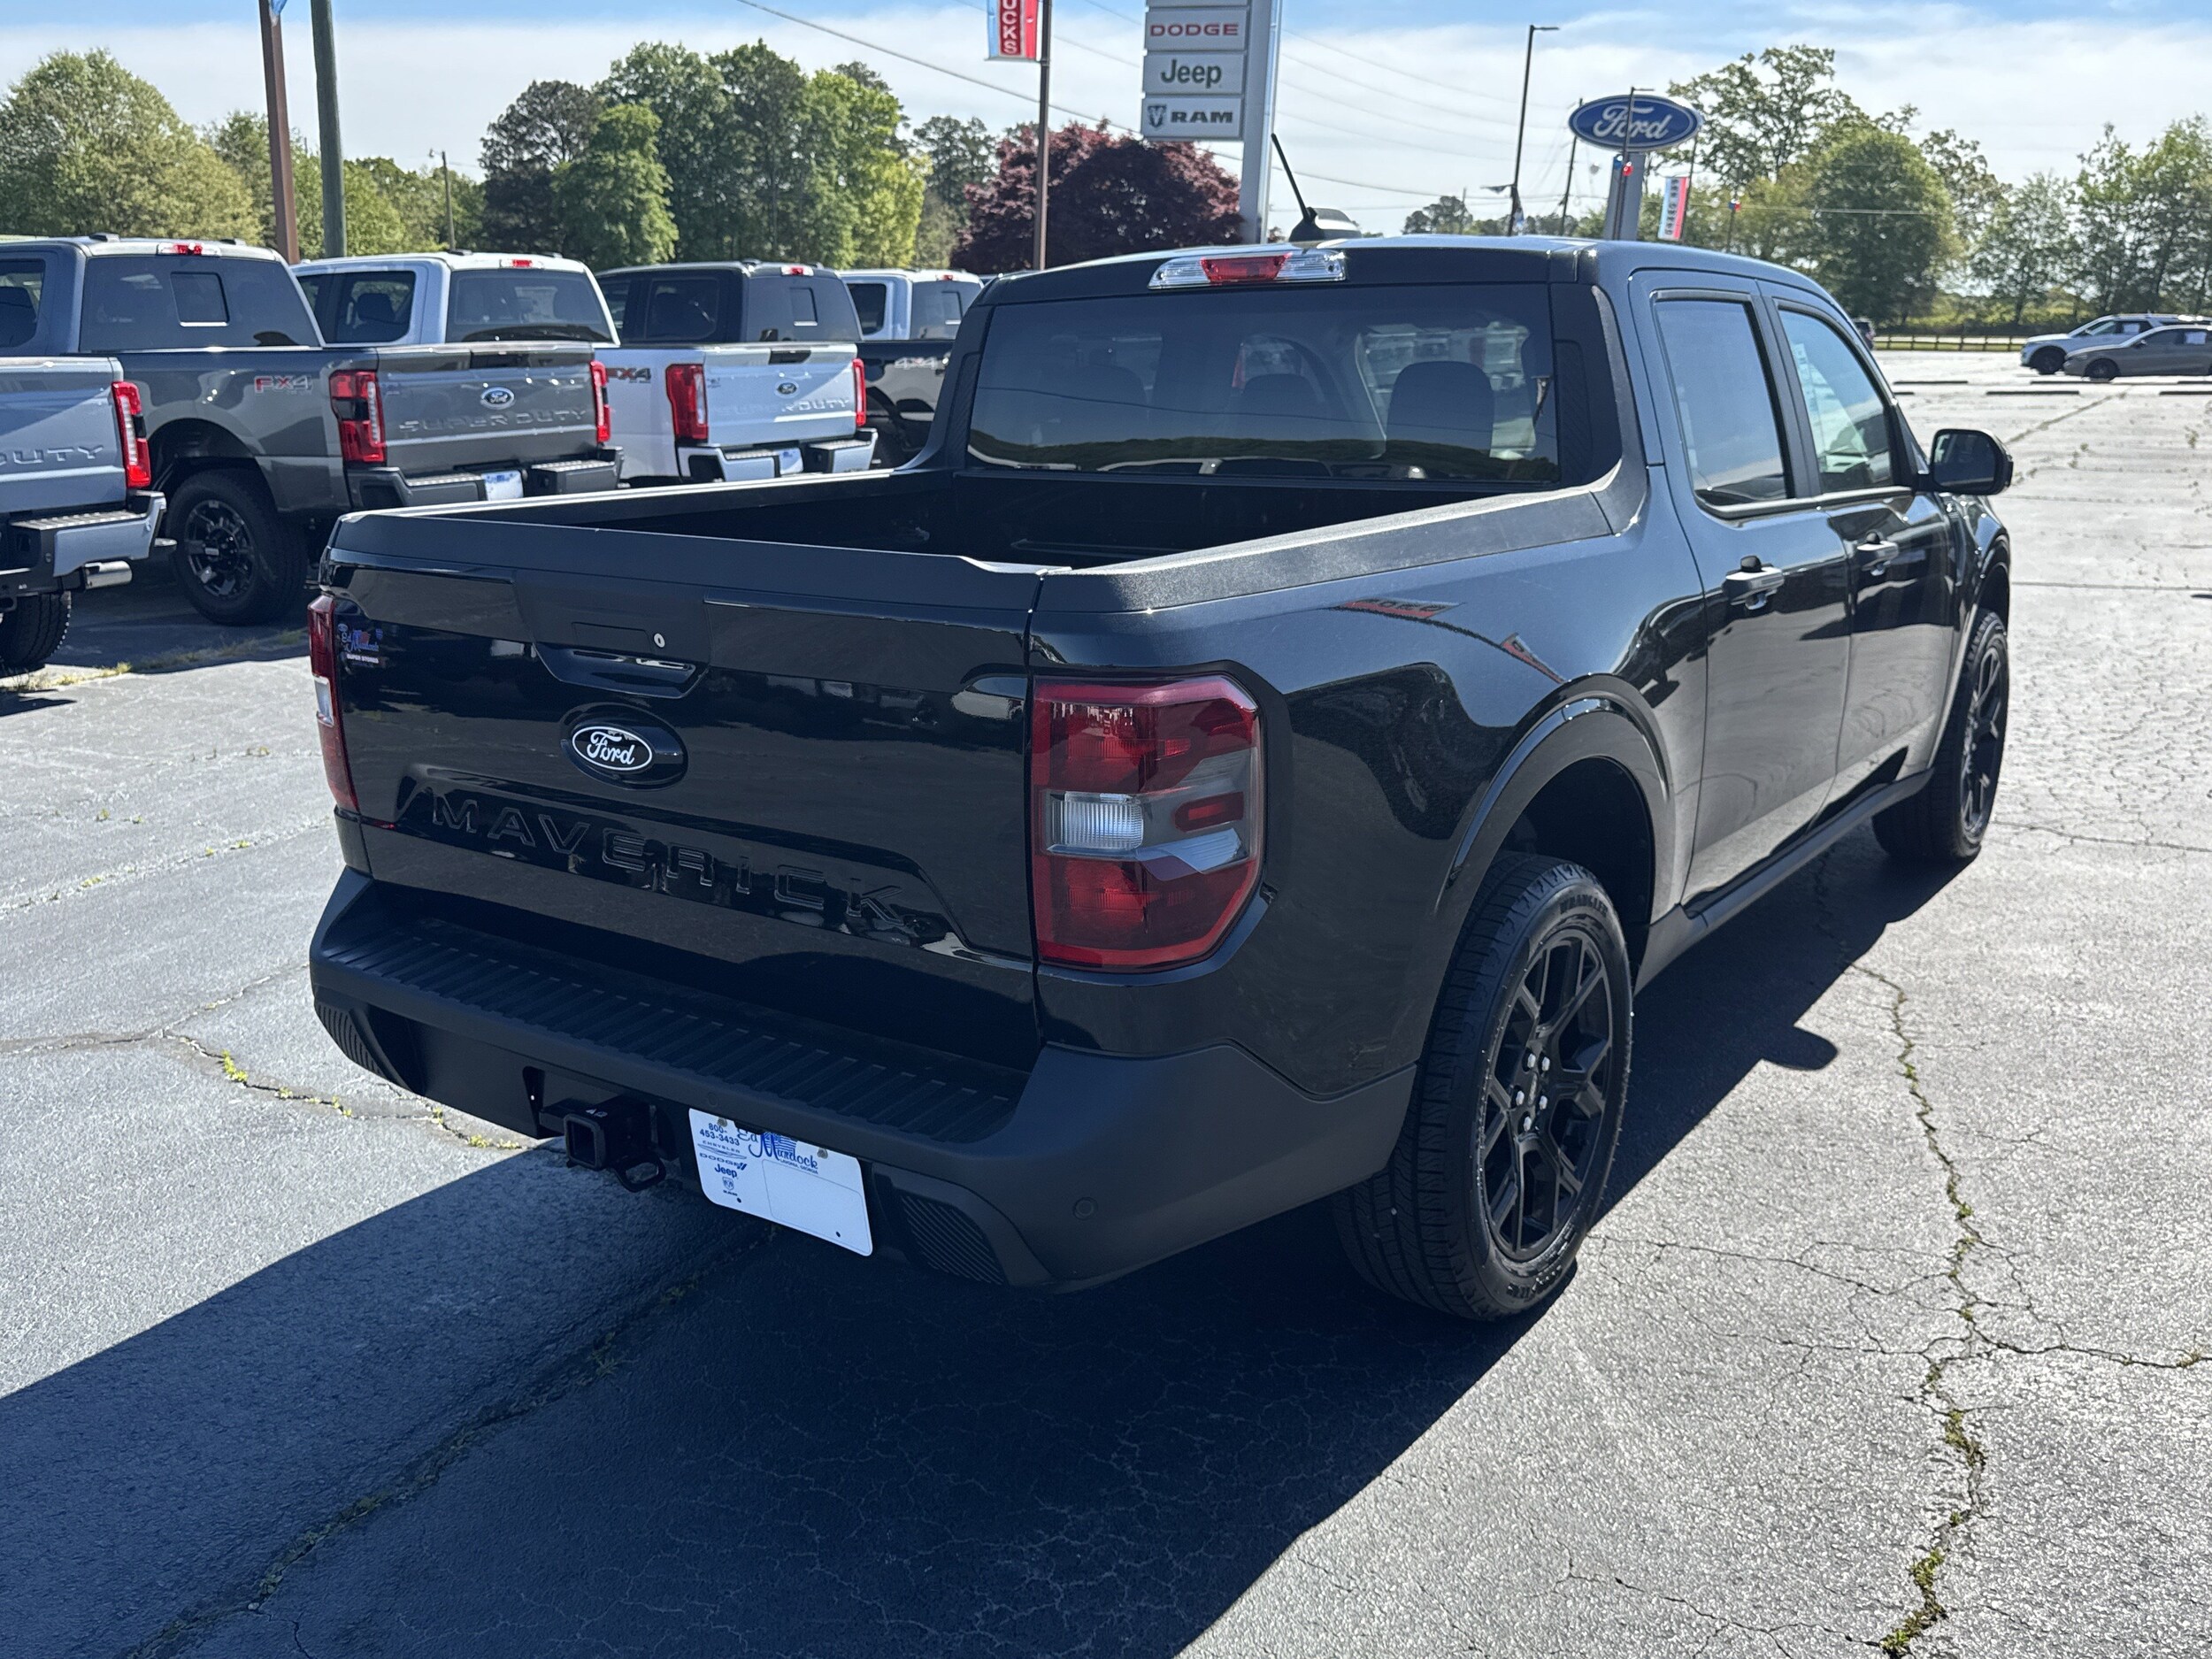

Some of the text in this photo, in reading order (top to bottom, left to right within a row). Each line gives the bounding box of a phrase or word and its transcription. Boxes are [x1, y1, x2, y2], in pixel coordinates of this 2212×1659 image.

[1150, 24, 1239, 36] DODGE
[1161, 58, 1222, 88] Jeep
[1171, 111, 1233, 124] RAM
[1593, 104, 1672, 139] Ford
[254, 375, 312, 394] FX4
[798, 398, 849, 411] DUTY
[399, 410, 587, 432] SUPER DUTY
[587, 730, 634, 765] Ford
[432, 798, 905, 926] MAVERICK
[708, 1122, 727, 1133] 800-
[700, 1129, 740, 1146] 453-3433
[703, 1140, 741, 1153] CHRYSLER
[699, 1153, 741, 1166] DODGE
[714, 1164, 738, 1179] Jeep
